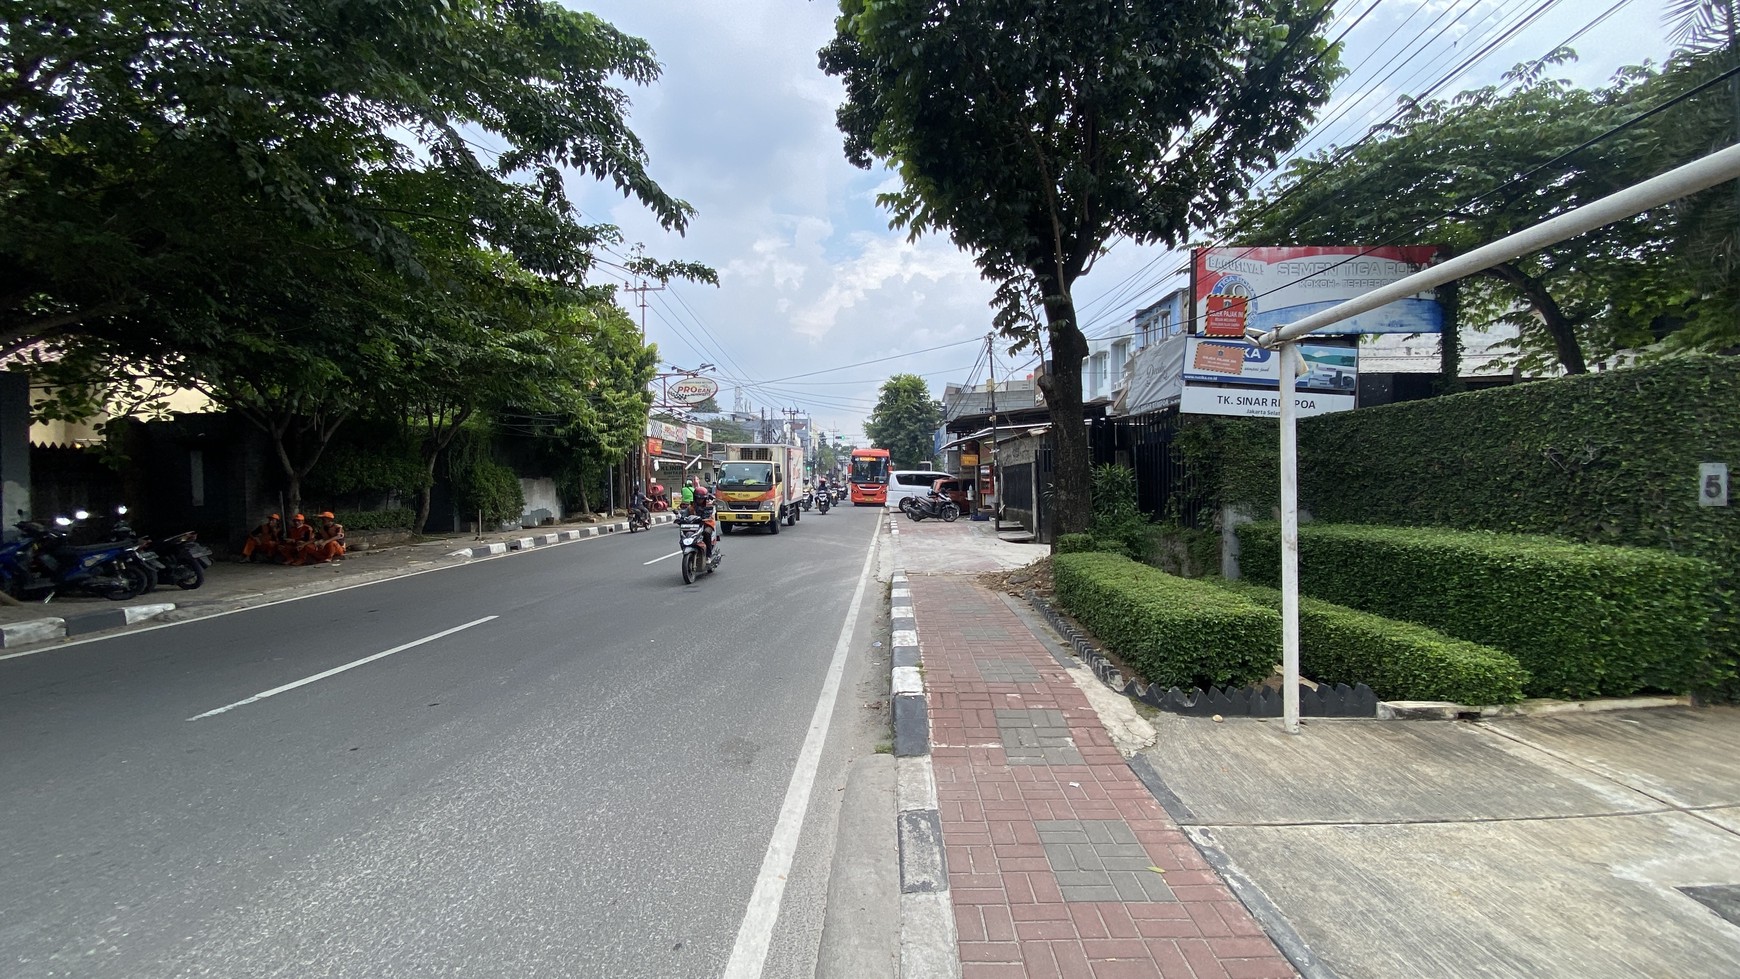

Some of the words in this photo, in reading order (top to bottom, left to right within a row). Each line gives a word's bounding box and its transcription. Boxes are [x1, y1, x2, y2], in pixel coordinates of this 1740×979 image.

[1277, 261, 1339, 277] SEMEN
[1343, 262, 1384, 277] TIGA
[1218, 276, 1235, 289] TIGA
[1217, 395, 1234, 405] TK.
[1236, 396, 1268, 407] SINAR
[1705, 474, 1722, 498] 5
